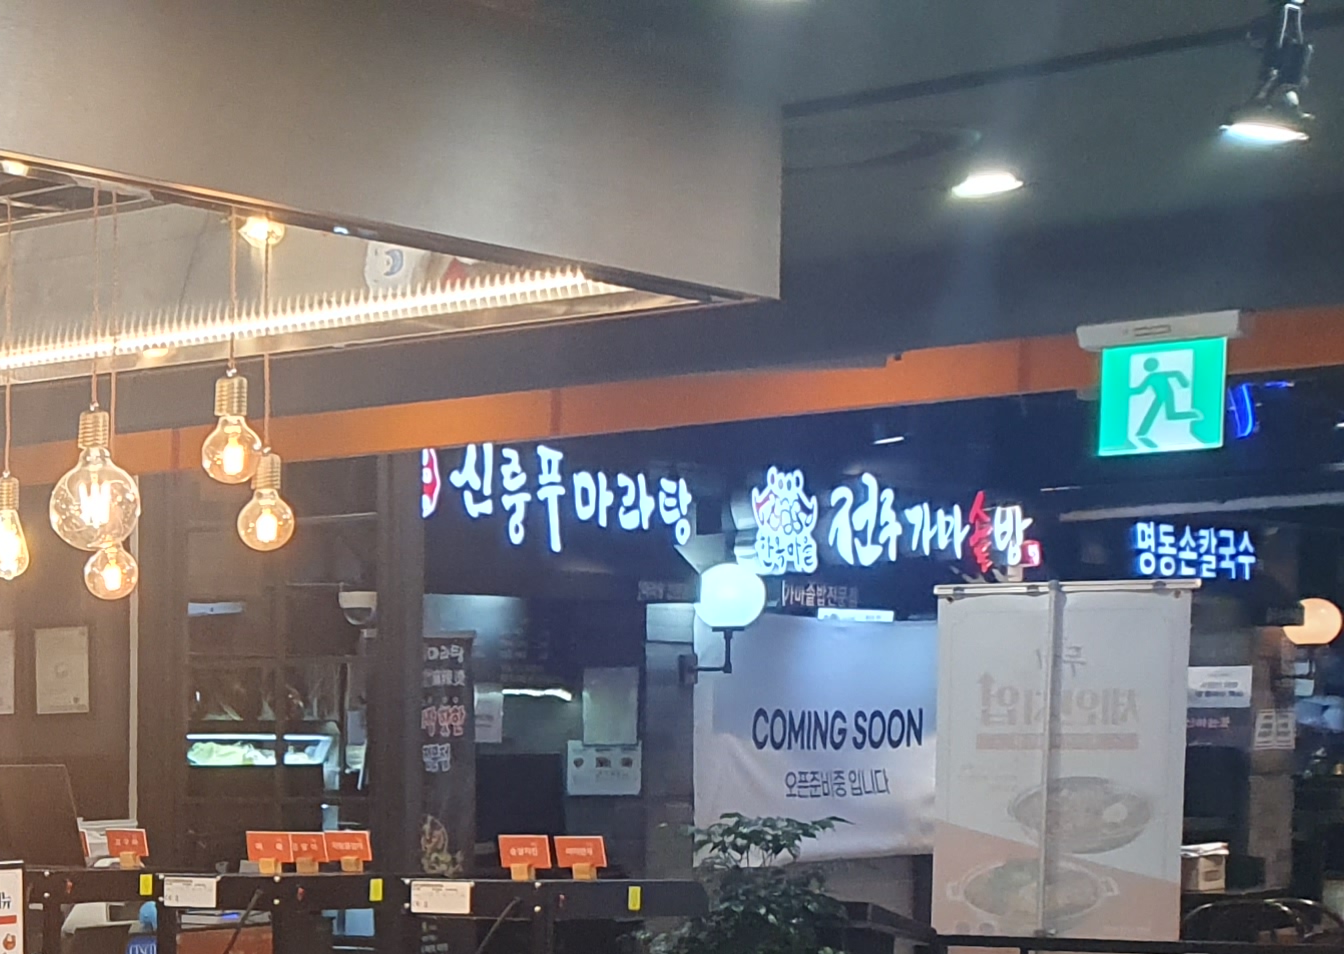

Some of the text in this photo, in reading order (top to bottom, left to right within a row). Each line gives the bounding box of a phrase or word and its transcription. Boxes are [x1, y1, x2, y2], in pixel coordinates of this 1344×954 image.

[1133, 521, 1256, 581] 명동손칼국수
[752, 707, 924, 750] COMING SOON
[785, 768, 890, 798] 오픈준비중 입니다
